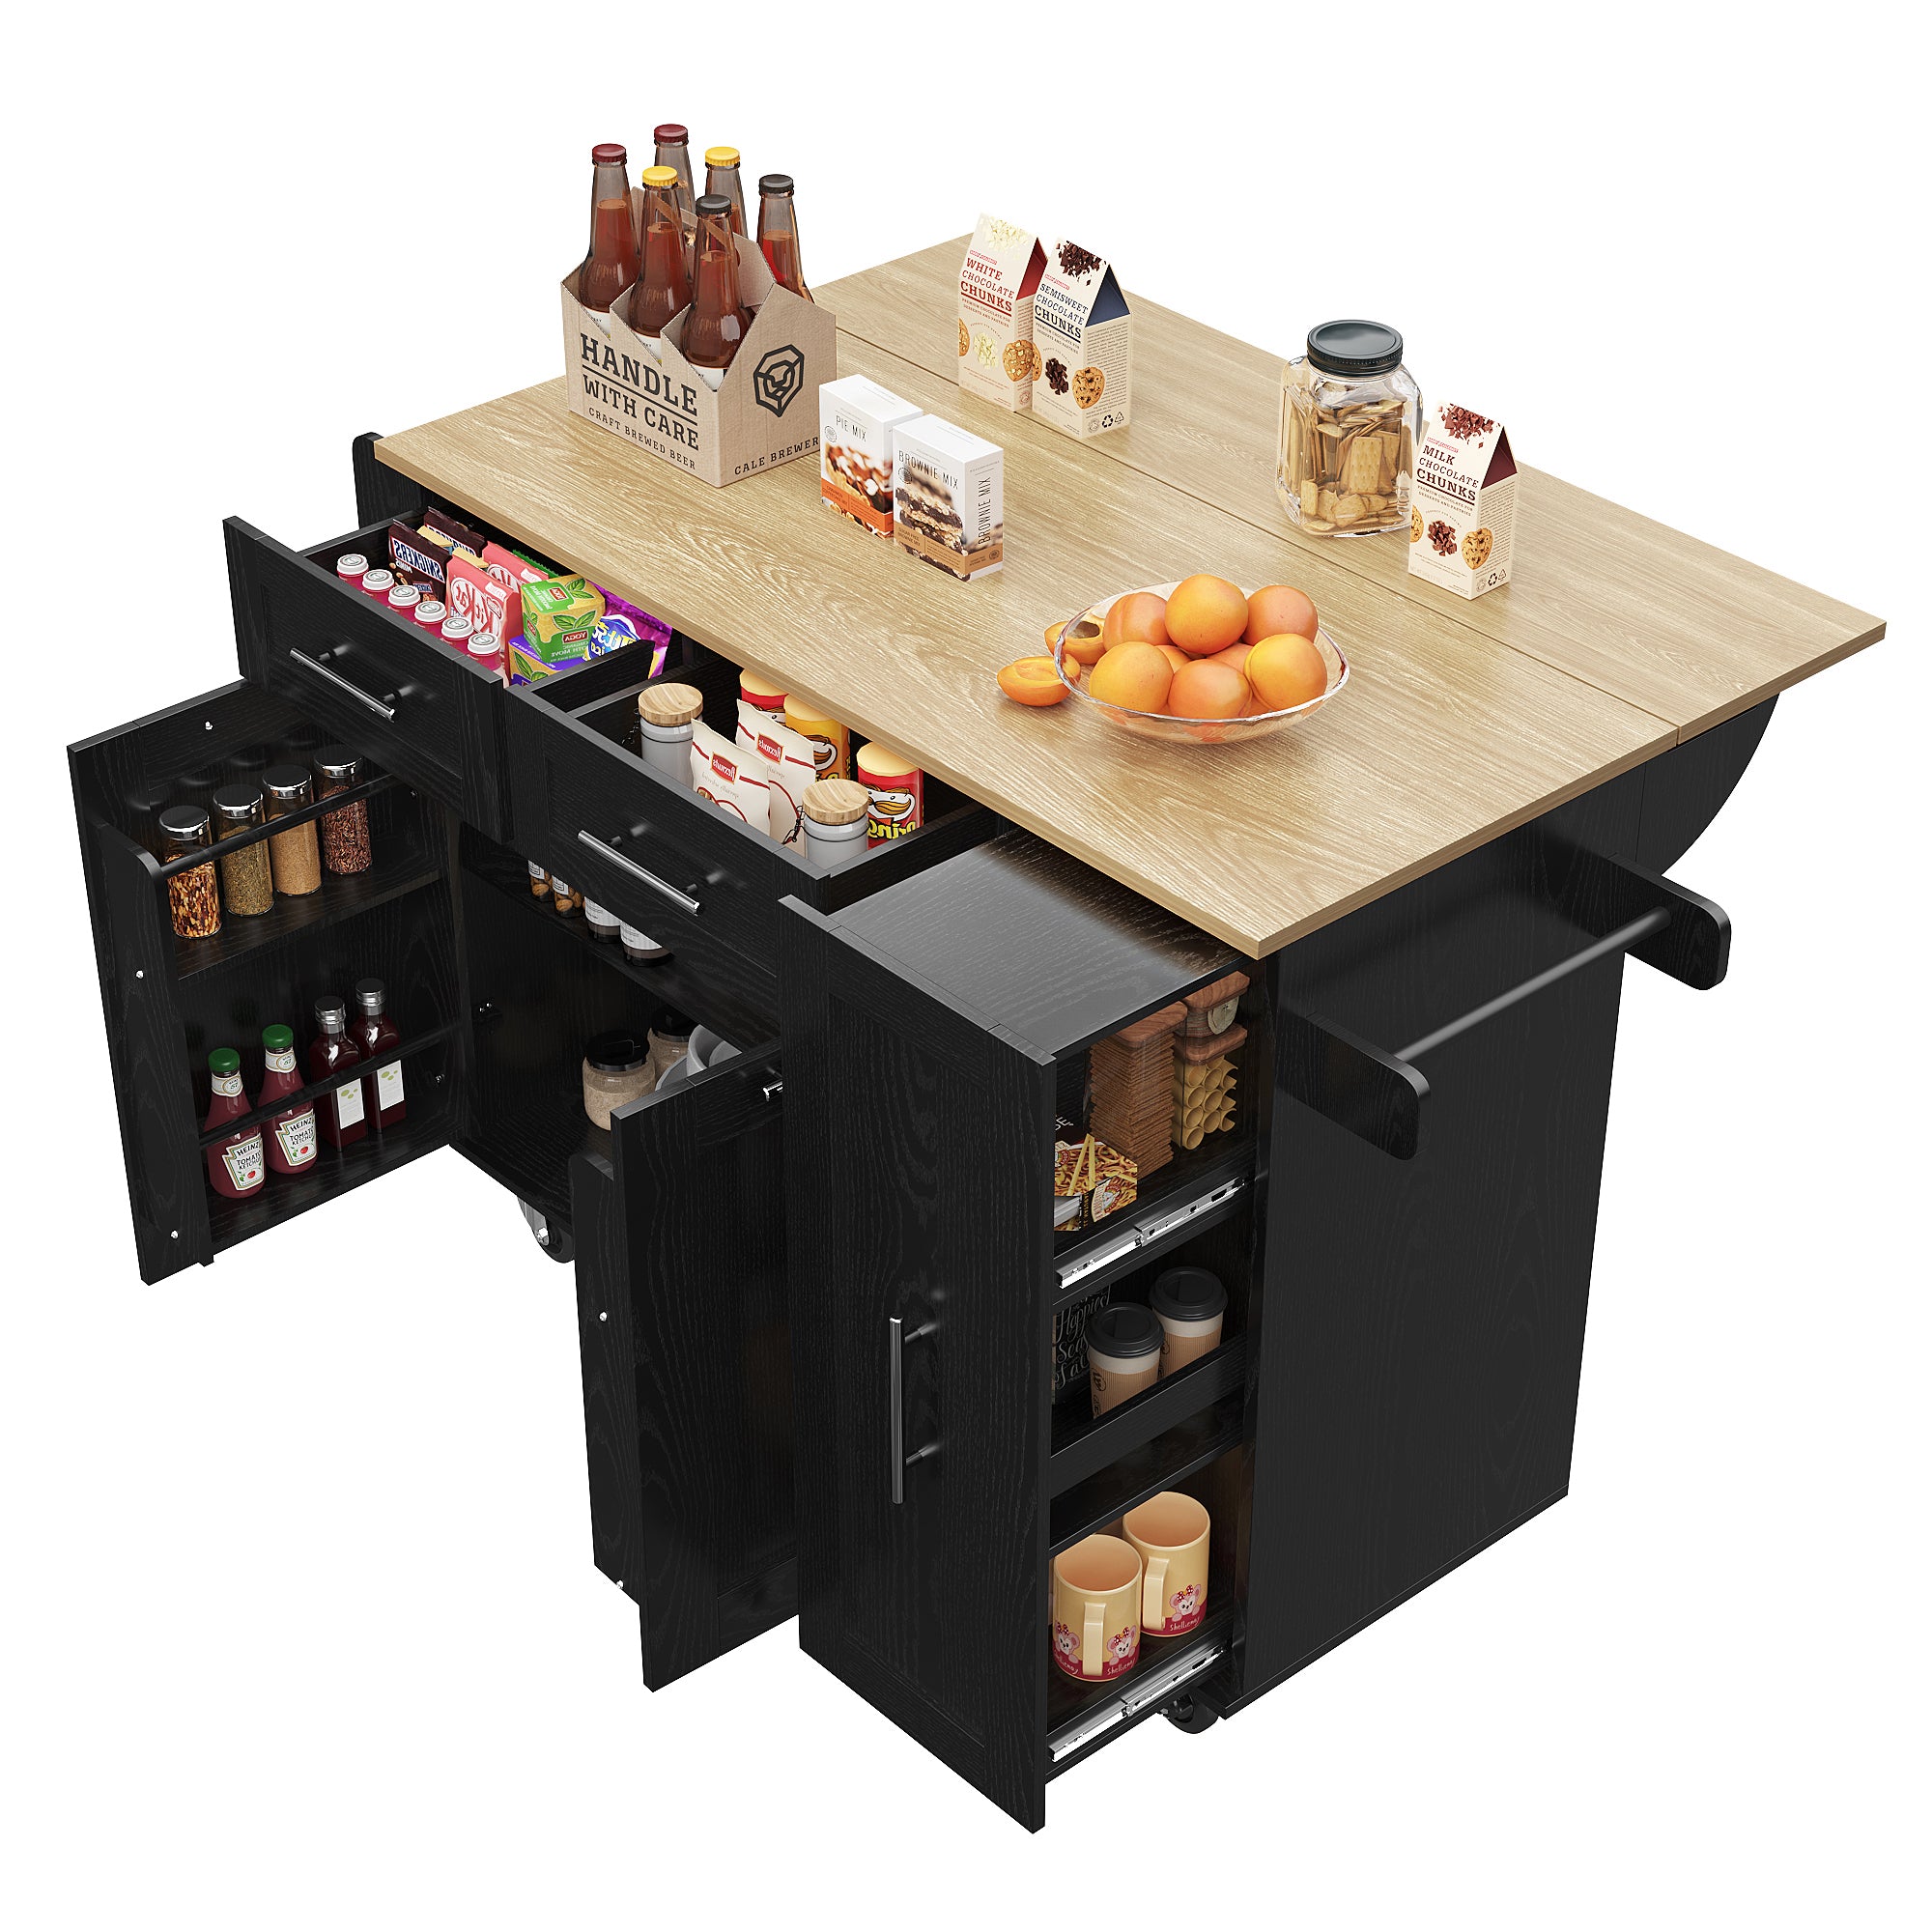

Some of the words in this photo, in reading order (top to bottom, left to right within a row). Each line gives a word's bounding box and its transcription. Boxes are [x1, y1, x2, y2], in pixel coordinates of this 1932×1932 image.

[967, 257, 1003, 280] WHITE
[961, 280, 1012, 311] CHUNKS
[962, 270, 1014, 298] CHOCOLATE
[1040, 284, 1088, 314] SEMISWEET
[1035, 305, 1081, 338] CHUNKS
[1037, 294, 1085, 326] CHOCOLATE
[581, 332, 697, 416] HANDLE
[582, 374, 637, 419] WITH
[644, 407, 699, 451] CARE
[588, 407, 620, 430] CRAFT
[625, 425, 666, 454] BREWED
[670, 450, 696, 469] BEER
[837, 415, 848, 431] PIE
[852, 425, 867, 442] MIX
[734, 457, 765, 475] CALE
[898, 450, 938, 479] BROWNIE
[942, 474, 958, 490] MIX
[1423, 445, 1455, 466] MILK
[979, 477, 991, 497] MIX
[1417, 469, 1475, 500] CHUNKS
[1419, 458, 1479, 488] CHOCOLATE
[979, 499, 991, 545] BROWNIE
[290, 1118, 312, 1132] HEINZ
[237, 1142, 259, 1155] HEINZ
